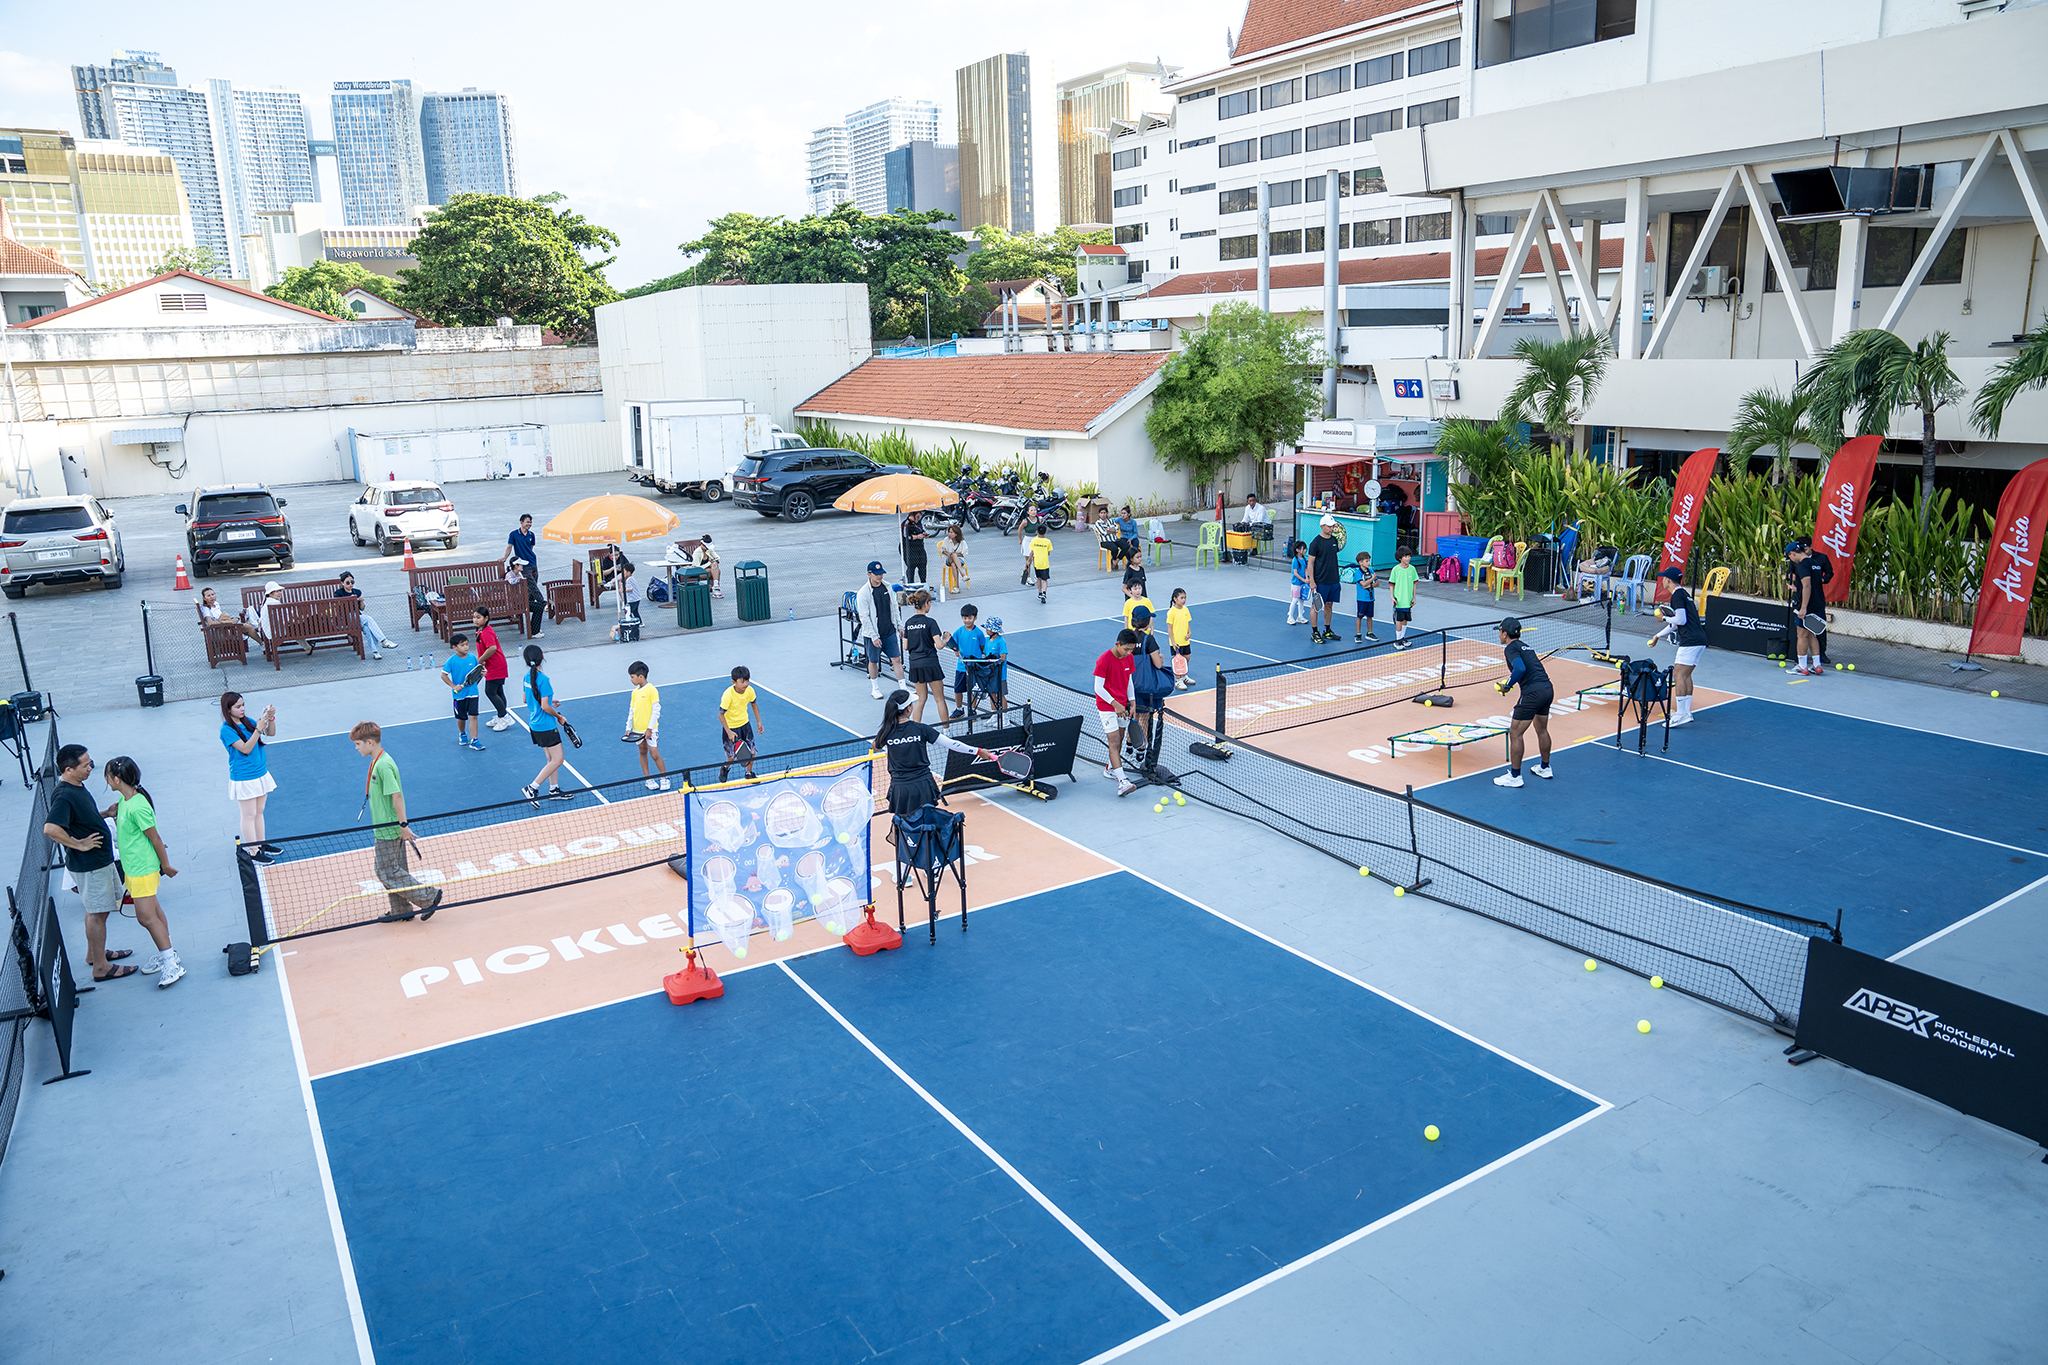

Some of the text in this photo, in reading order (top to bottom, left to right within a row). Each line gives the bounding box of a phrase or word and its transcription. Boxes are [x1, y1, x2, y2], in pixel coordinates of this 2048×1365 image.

[334, 248, 384, 258] Nagaworld
[1722, 614, 1758, 630] APEX
[887, 735, 921, 746] COACH
[1843, 988, 1940, 1039] APEX
[1933, 1031, 1997, 1059] ACADEMY
[1934, 1021, 2015, 1057] PICKLEBALL
